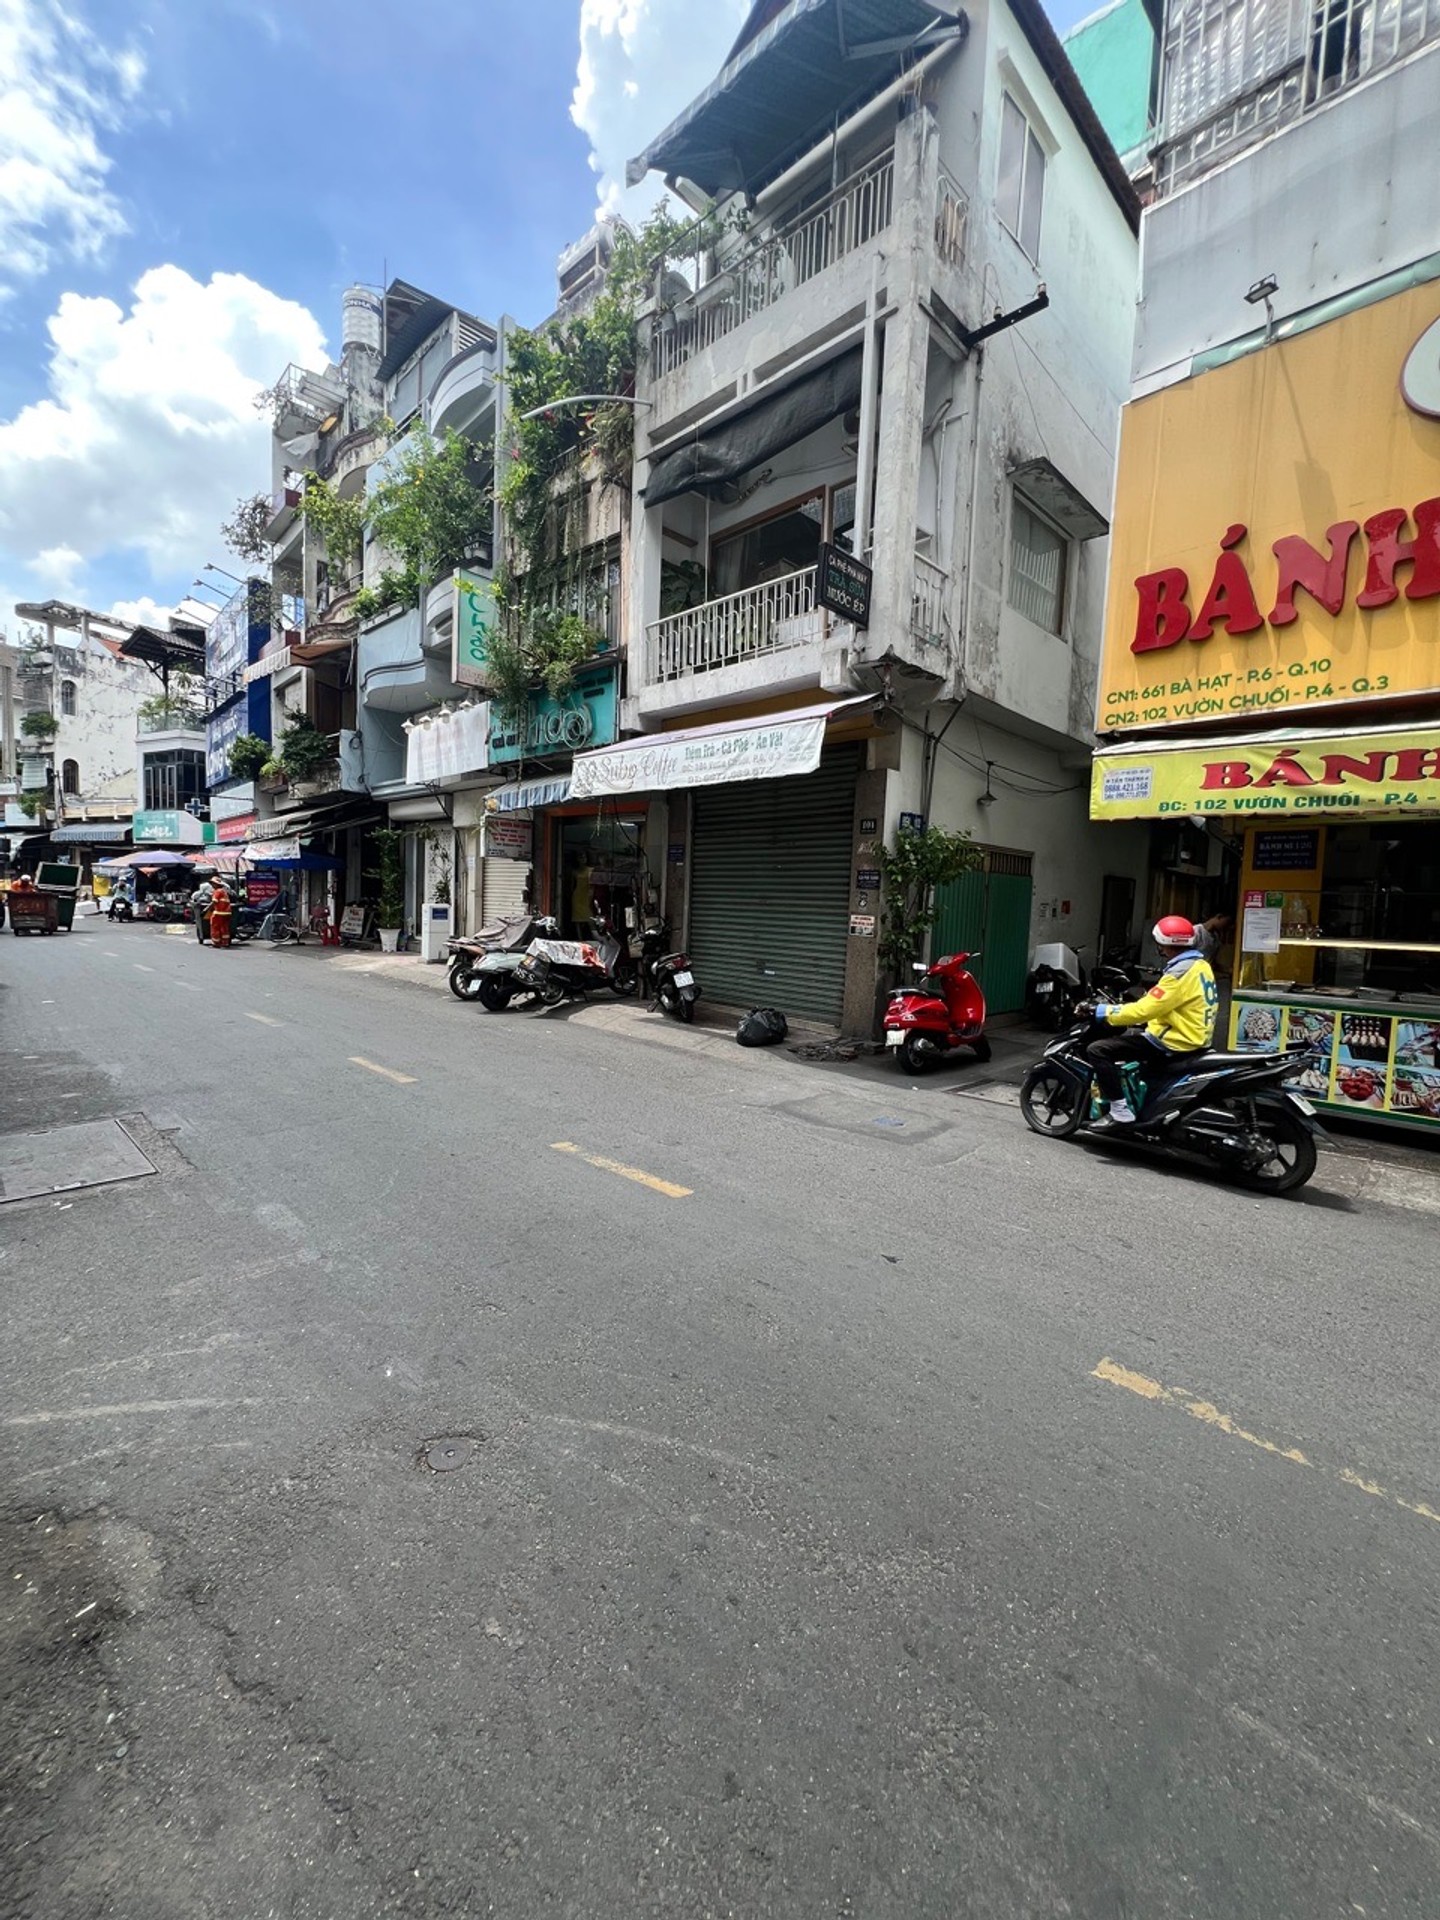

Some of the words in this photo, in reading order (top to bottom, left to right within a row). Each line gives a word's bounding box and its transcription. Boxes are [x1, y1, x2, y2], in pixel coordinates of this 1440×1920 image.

[1130, 497, 1440, 654] BÁNH
[1105, 711, 1139, 726] CN2:
[1143, 706, 1167, 721] 102
[1173, 698, 1224, 717] VƯỜN
[1229, 684, 1290, 709] CHUỐI
[1306, 682, 1334, 699] P.4
[1107, 689, 1138, 704] CN1:
[1142, 684, 1165, 699] 661
[1170, 678, 1192, 695] BÀ
[1198, 673, 1232, 692] HẠT
[1247, 668, 1272, 684] P.6
[1194, 798, 1227, 810] 102
[1233, 794, 1287, 810] VƯỜN
[1294, 790, 1361, 808] CHUỐI
[1384, 792, 1418, 805] P.4
